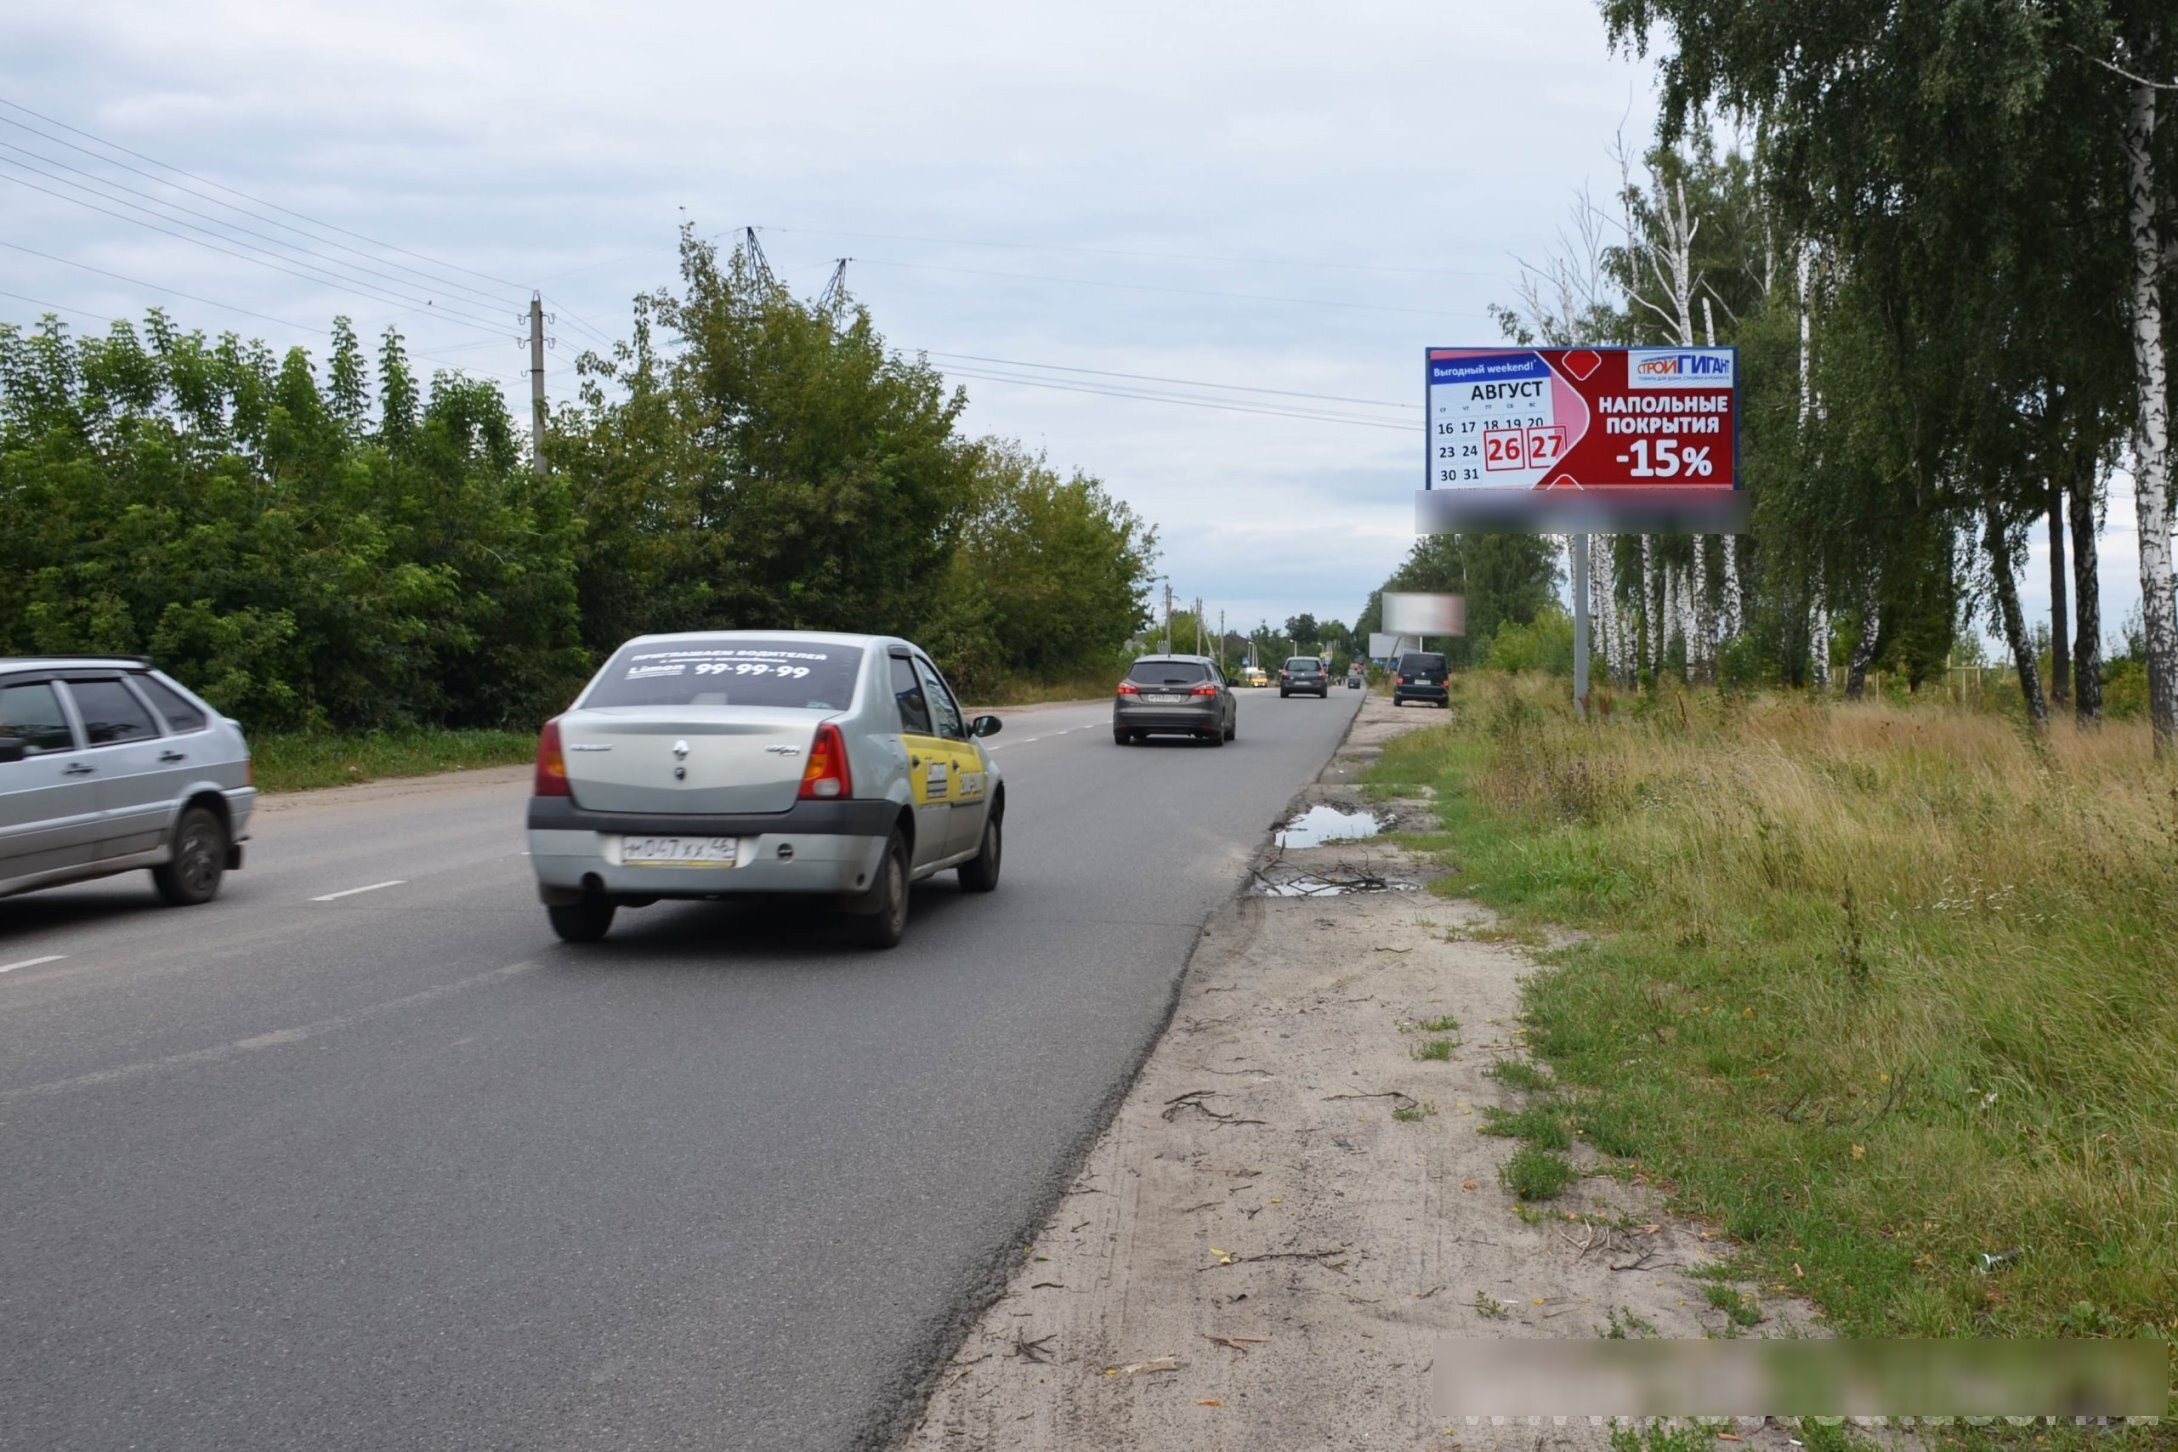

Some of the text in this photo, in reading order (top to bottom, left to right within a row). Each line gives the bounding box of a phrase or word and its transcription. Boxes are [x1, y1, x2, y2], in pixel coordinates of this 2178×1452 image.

[1433, 363, 1485, 378] Выгодный
[1471, 381, 1543, 401] АВГУСТ
[1599, 395, 1728, 414] НАПОЛЬНЫЕ
[1438, 417, 1543, 435] 16 17 18 19 20
[1607, 416, 1720, 434] ПОКРЫТИЯ
[1439, 435, 1562, 461] 23 24 26 27
[1616, 439, 1713, 477] -15%
[1441, 468, 1479, 481] 30 31
[631, 650, 734, 662] ПРИГЛАШАЕМ
[736, 650, 828, 661] ВОДИТЕЛЕЙ
[695, 663, 810, 679] 99-99-99
